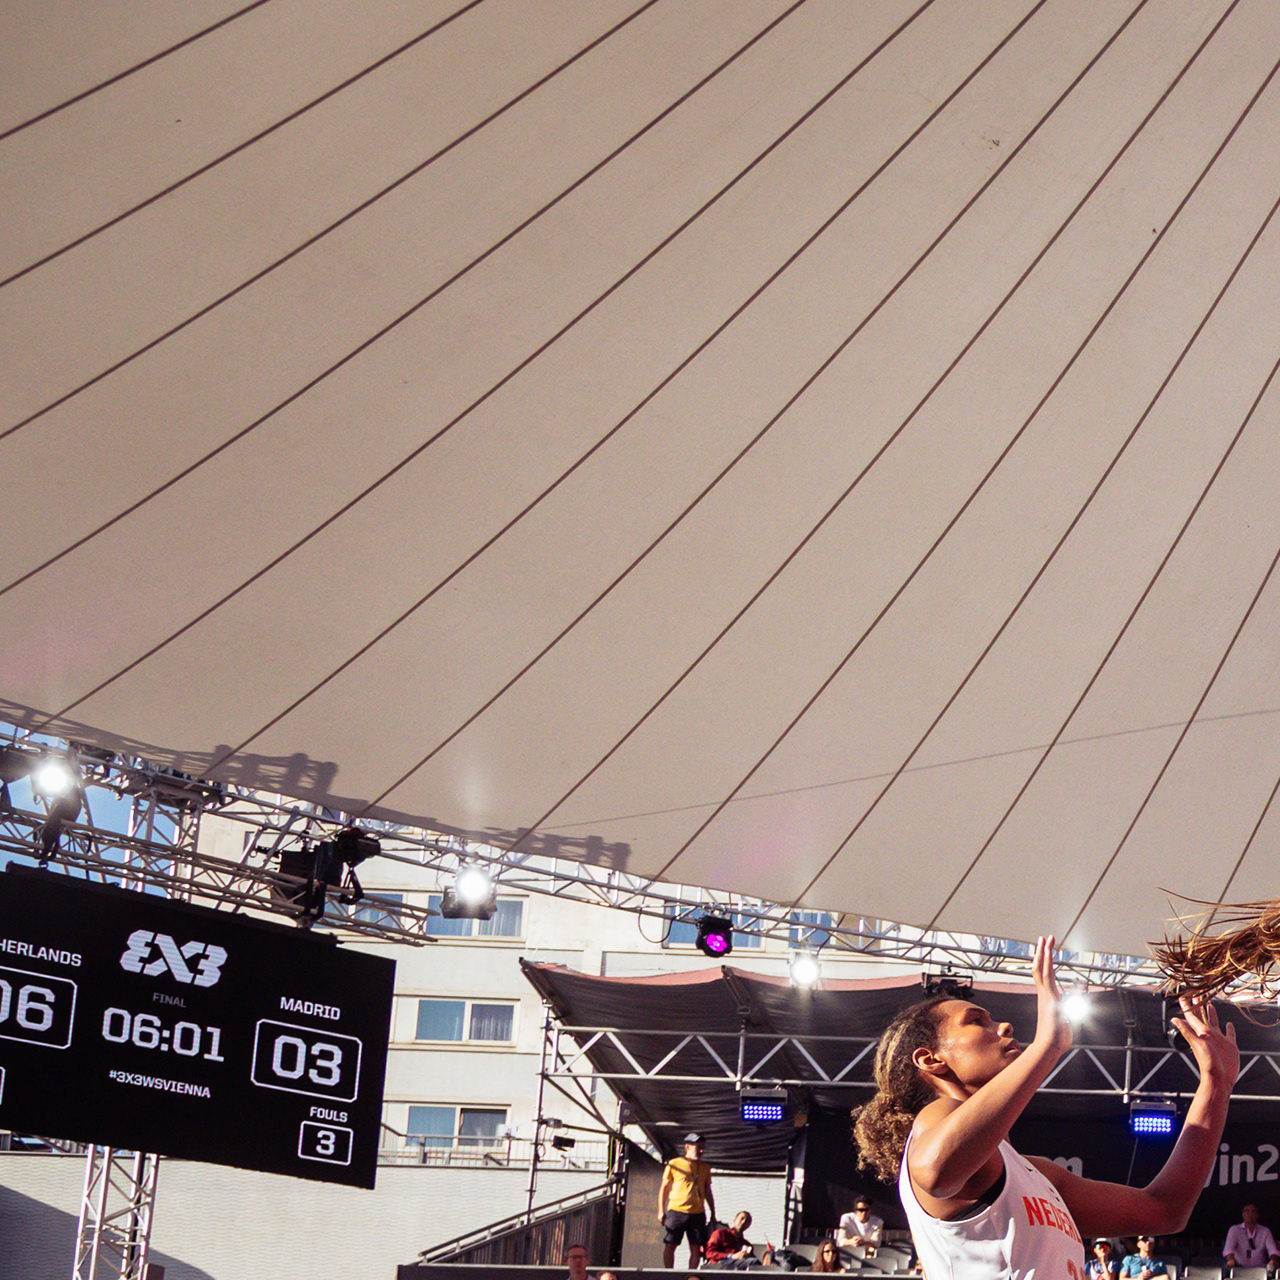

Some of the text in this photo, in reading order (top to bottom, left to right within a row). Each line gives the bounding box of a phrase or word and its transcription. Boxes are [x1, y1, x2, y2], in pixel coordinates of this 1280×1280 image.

[153, 992, 187, 1008] FINAL
[280, 996, 341, 1021] MADRID
[101, 1006, 226, 1063] 06:01
[271, 1034, 344, 1087] 03
[109, 1069, 211, 1099] #3X3WSVIENNA
[309, 1105, 348, 1123] FOULS
[315, 1130, 336, 1156] 3
